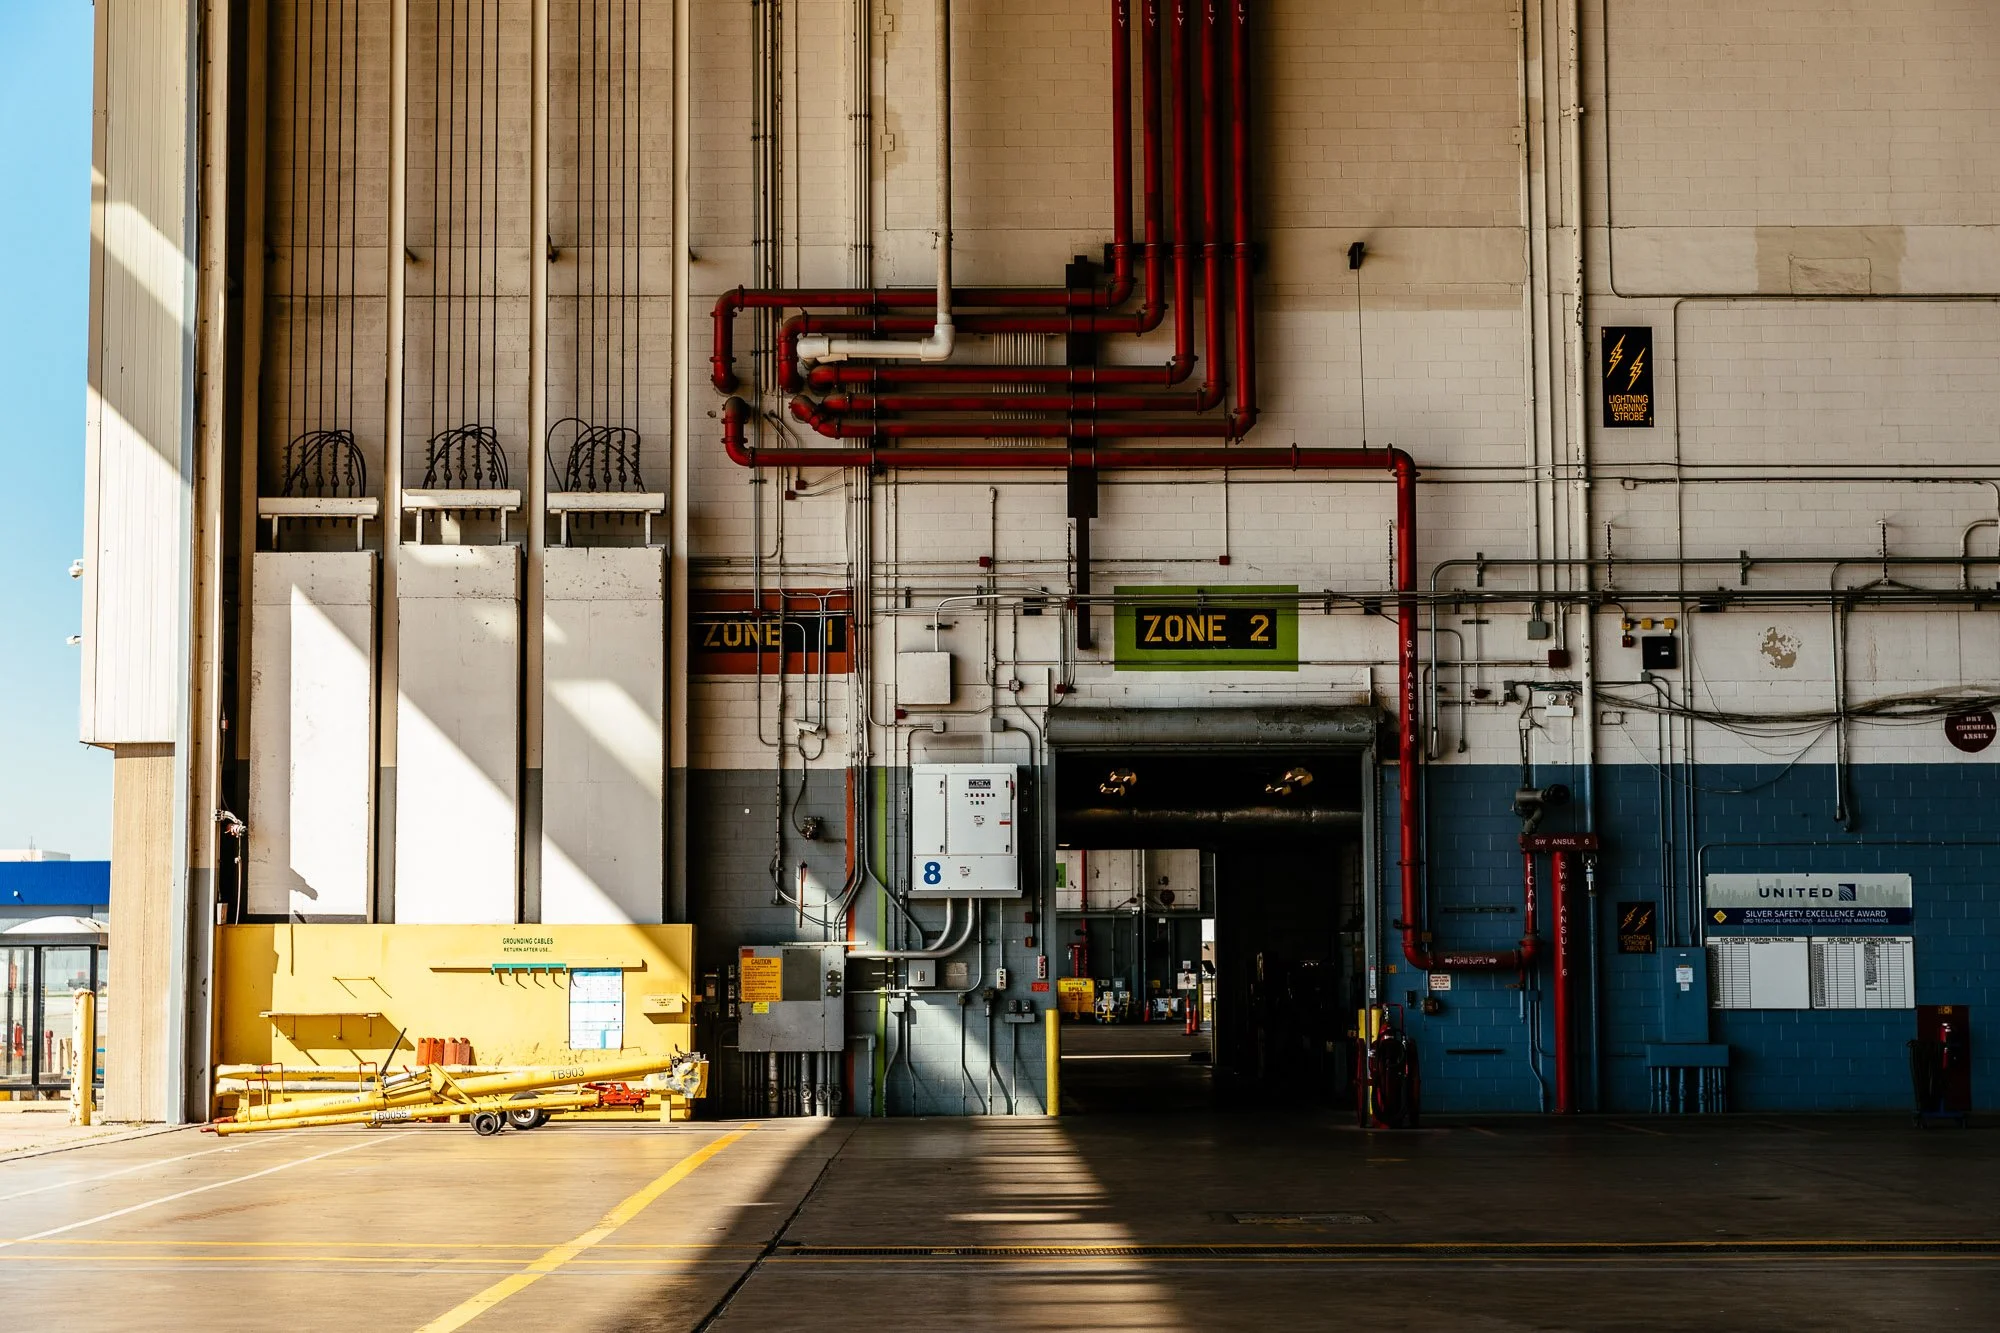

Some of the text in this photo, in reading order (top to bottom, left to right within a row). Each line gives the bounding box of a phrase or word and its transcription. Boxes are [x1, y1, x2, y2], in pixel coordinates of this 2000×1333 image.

[1608, 394, 1648, 404] LIGHTNING
[1611, 404, 1647, 412] WARNING
[1614, 412, 1644, 421] STROBE
[703, 618, 833, 646] ZONE 1
[1143, 614, 1270, 642] ZONE 2
[1409, 734, 1415, 742] 6
[924, 862, 941, 884] 8
[1526, 862, 1536, 912] FOAM
[1759, 888, 1833, 898] UNITED
[1453, 956, 1488, 964] FOAM SUPPLY
[1562, 968, 1568, 976] 6
[551, 1067, 584, 1080] TB903
